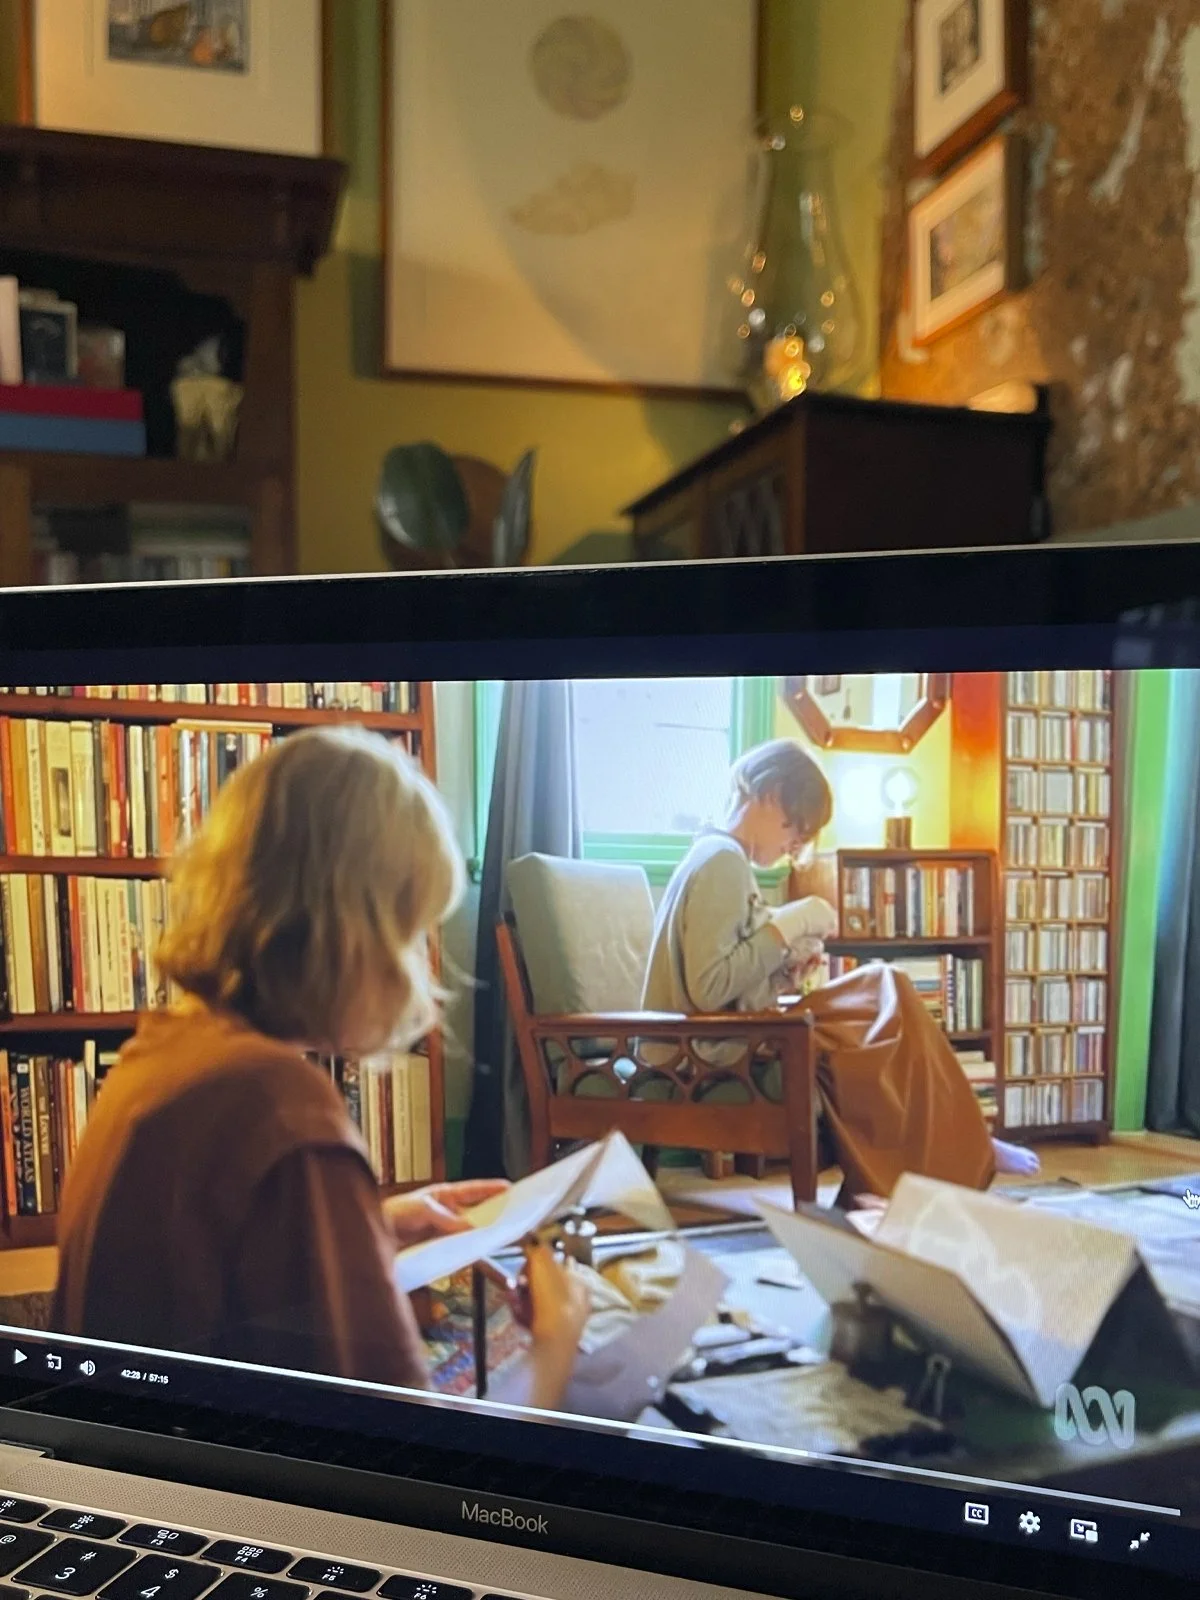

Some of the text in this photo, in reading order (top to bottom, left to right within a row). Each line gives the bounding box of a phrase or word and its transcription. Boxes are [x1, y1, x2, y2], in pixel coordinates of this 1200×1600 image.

[148, 1373, 169, 1385] 57:15
[461, 1500, 549, 1535] MacBook
[971, 1508, 983, 1519] CC
[234, 1555, 249, 1563] F4
[55, 1567, 76, 1580] 3
[164, 1568, 179, 1580] $
[140, 1585, 161, 1599] 4
[250, 1586, 269, 1598] %
